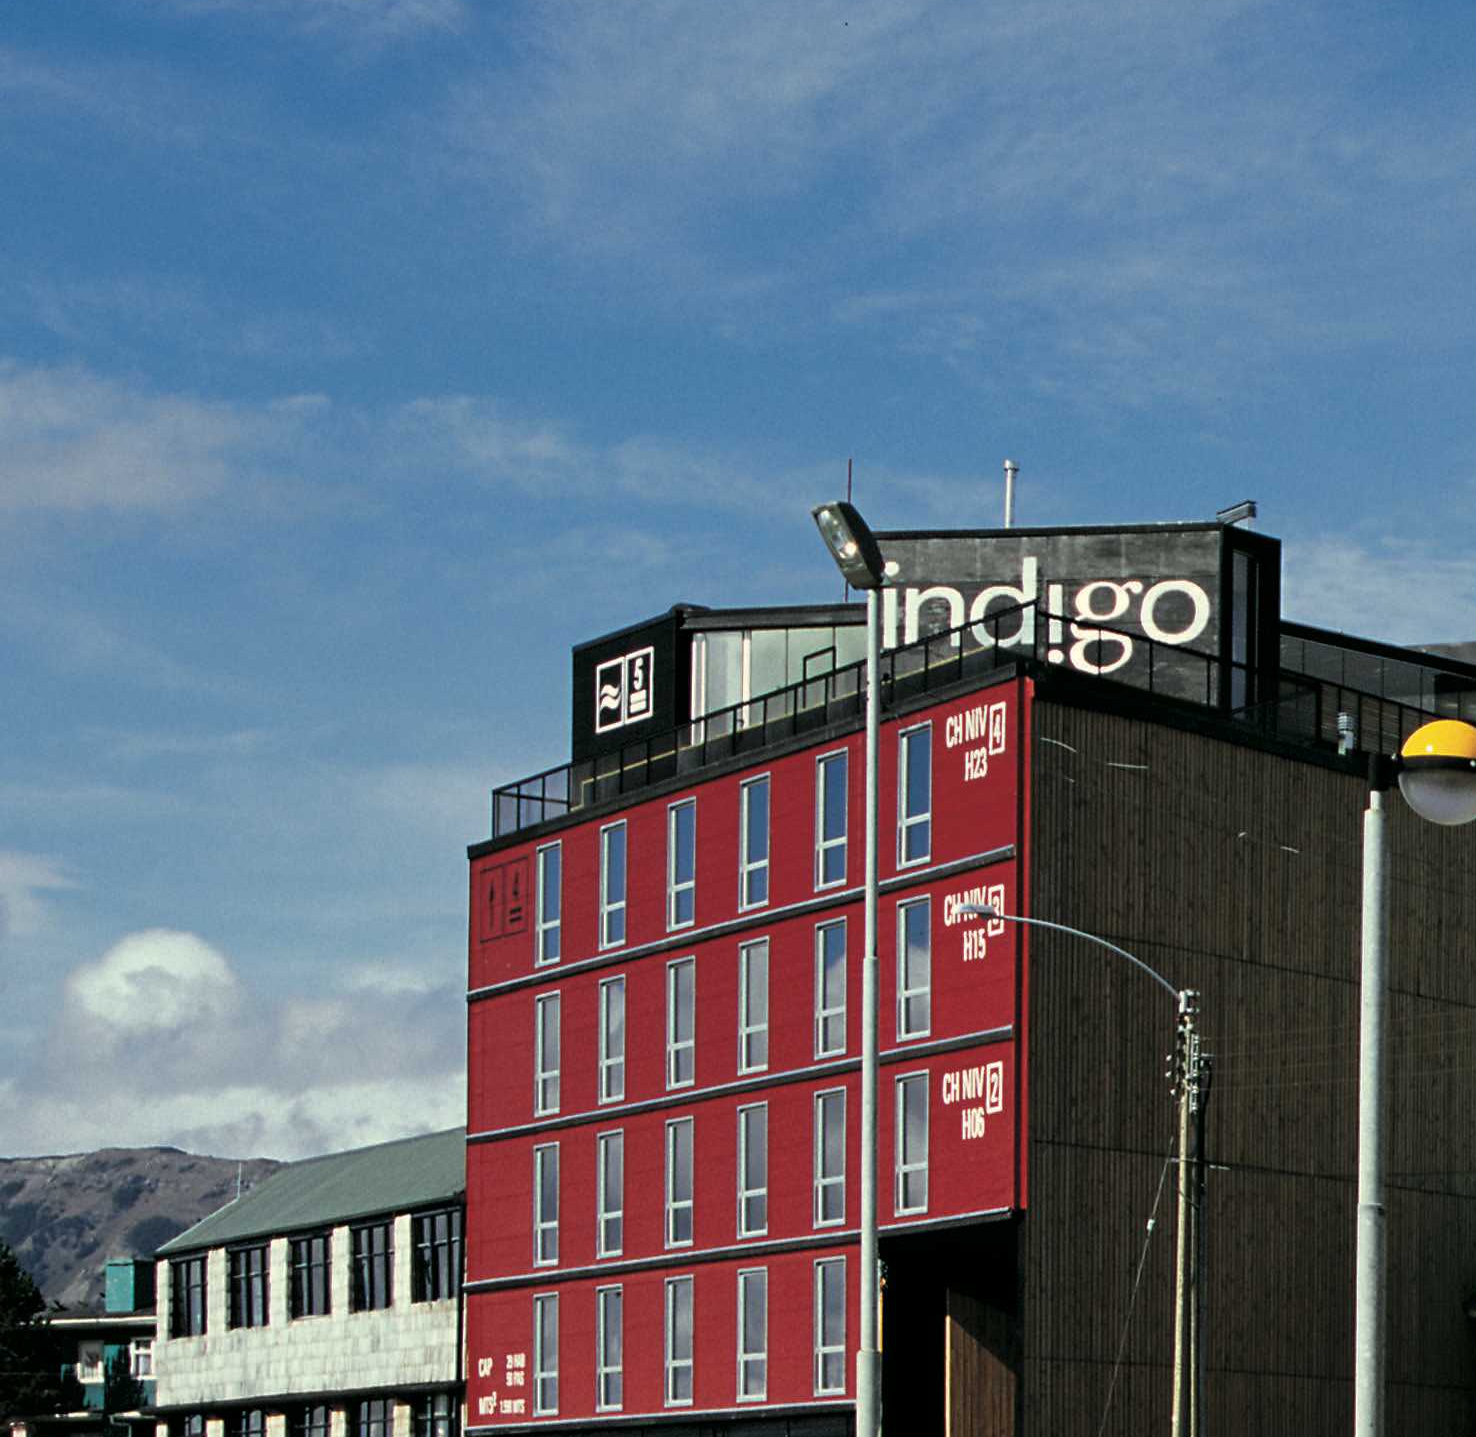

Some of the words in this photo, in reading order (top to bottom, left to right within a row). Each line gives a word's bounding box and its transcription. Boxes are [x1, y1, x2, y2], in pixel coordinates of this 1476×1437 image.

[882, 556, 1211, 674] indigo
[633, 657, 644, 691] 5
[945, 713, 963, 748] CH
[965, 704, 988, 742] NIV
[964, 746, 988, 782] H23
[944, 892, 961, 927] CH
[963, 928, 987, 962] H15
[942, 1071, 960, 1105] CH
[962, 1065, 985, 1100] NIV
[961, 1106, 985, 1140] H06
